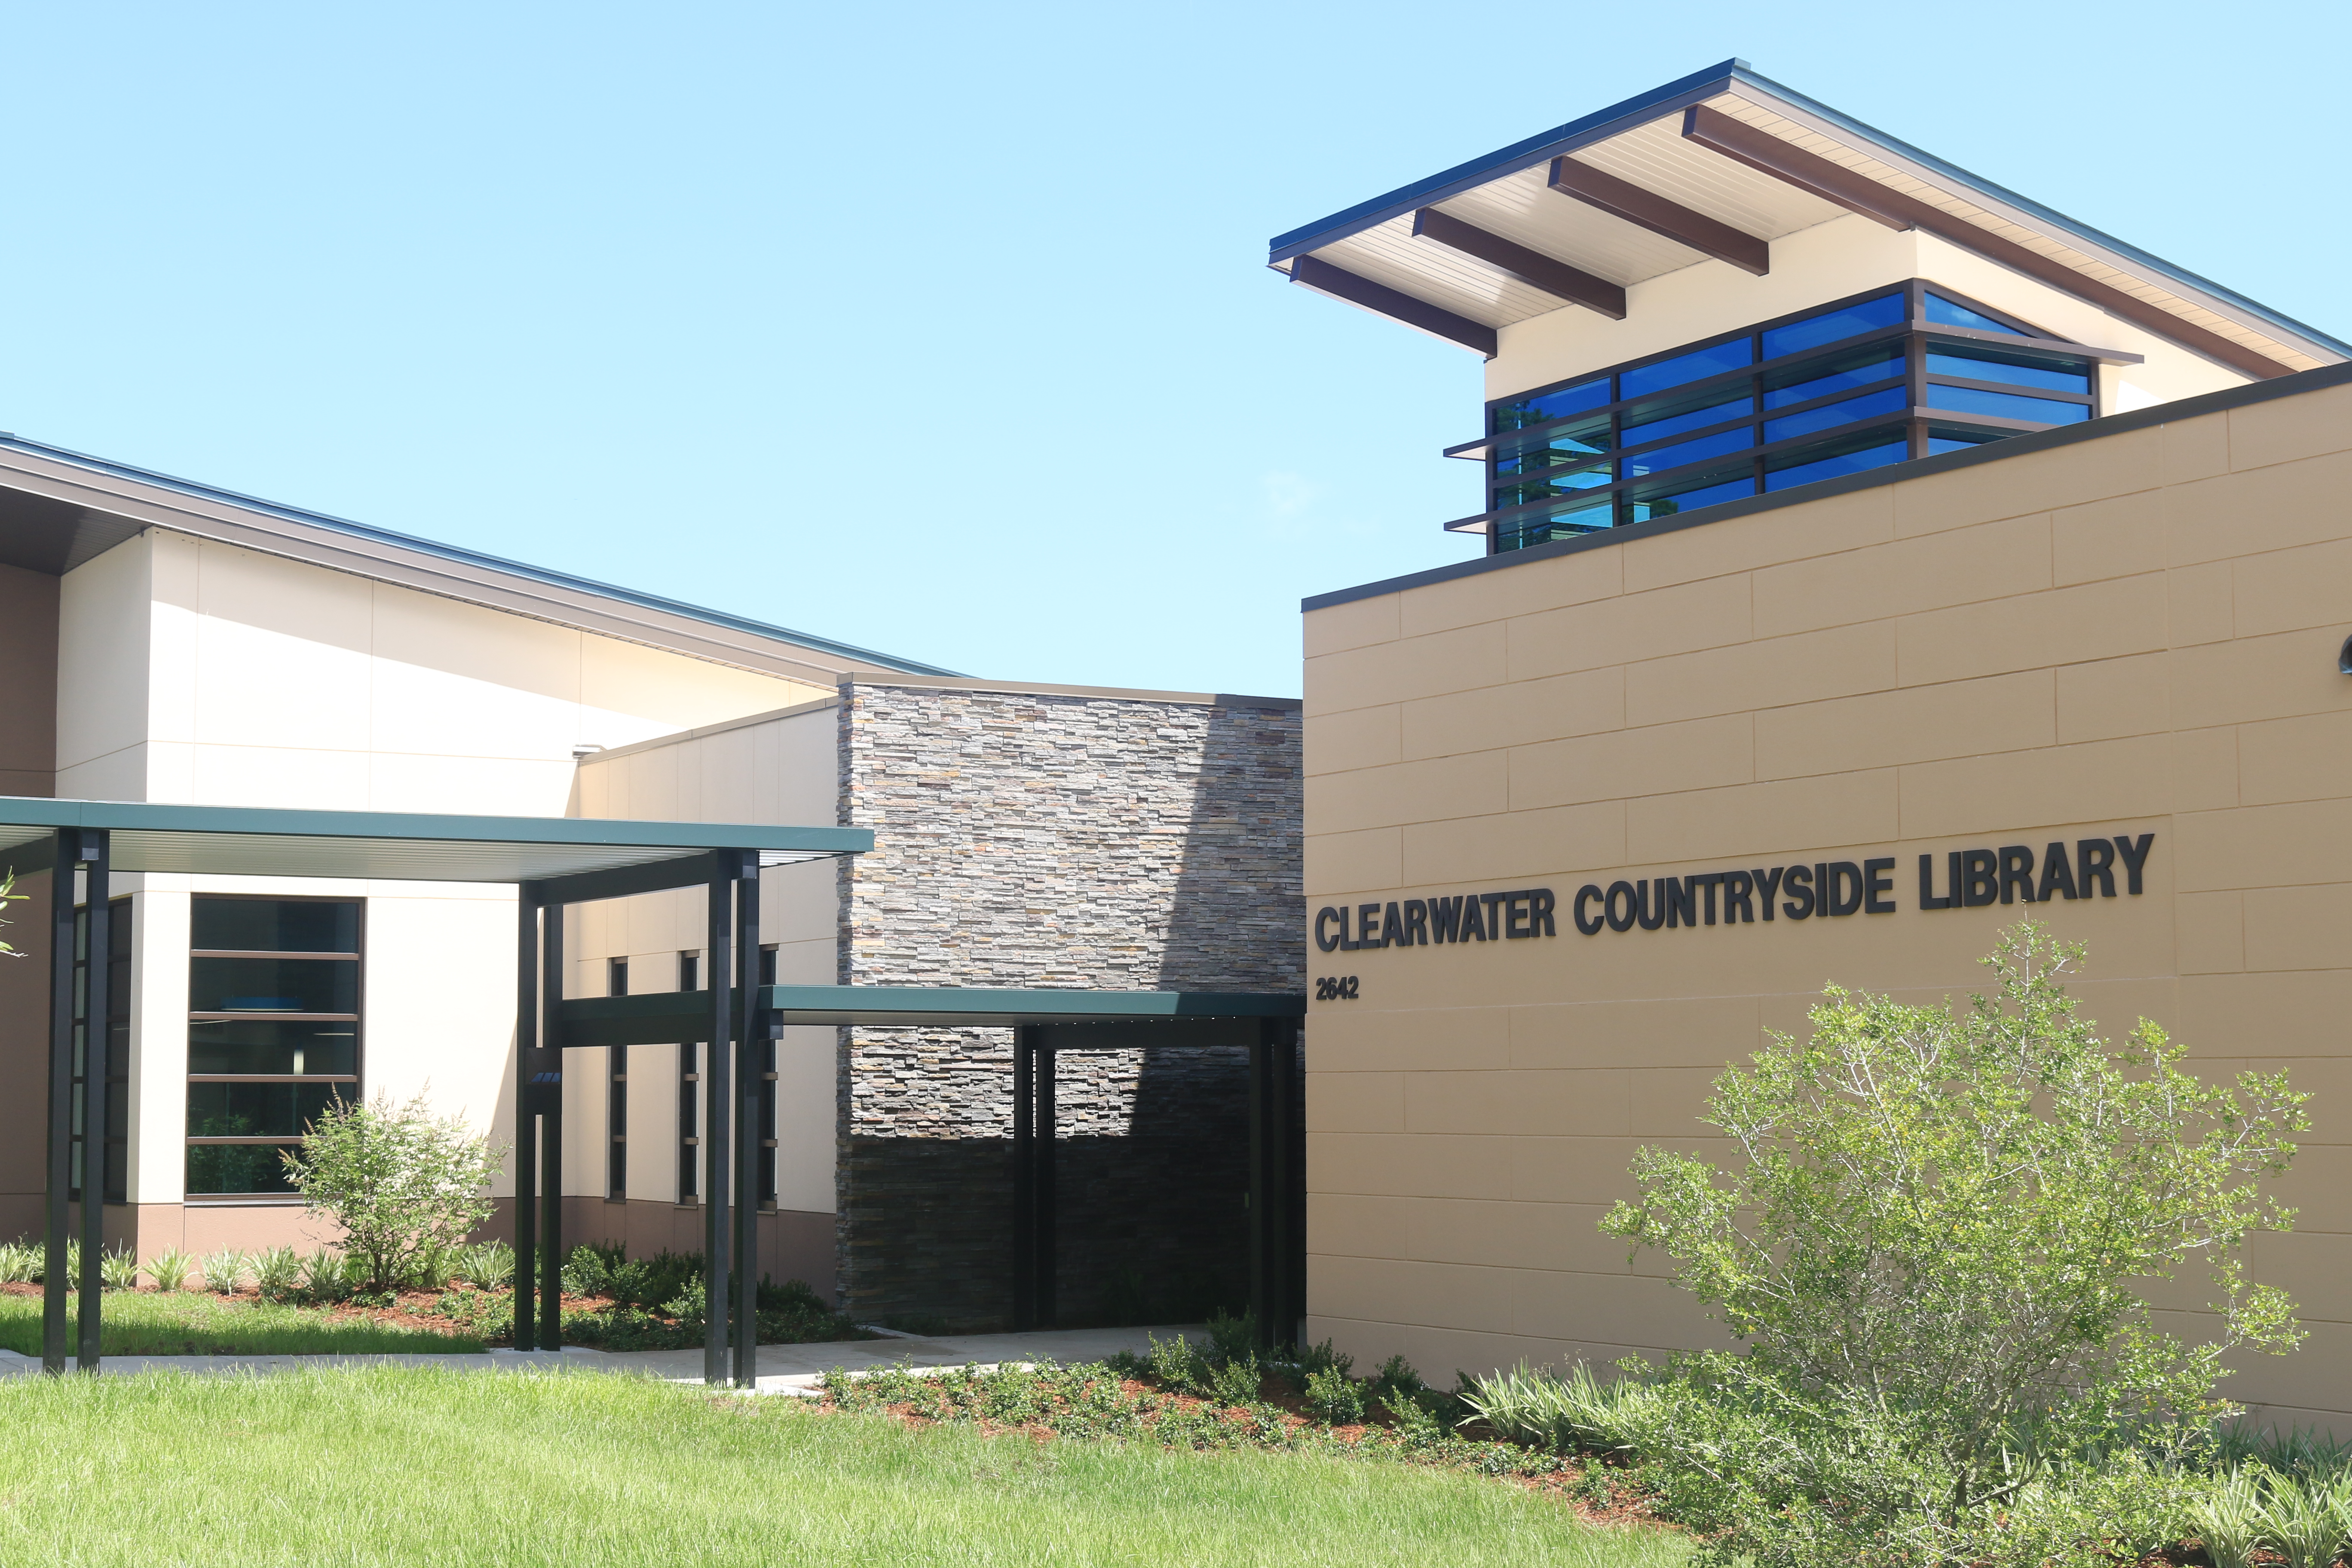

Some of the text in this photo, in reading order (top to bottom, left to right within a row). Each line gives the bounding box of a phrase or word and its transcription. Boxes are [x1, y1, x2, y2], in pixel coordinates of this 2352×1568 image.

[1315, 833, 2155, 953] CLEARWATER COUNTRYSIDE LIBRARY
[1316, 976, 1359, 1001] 2642
